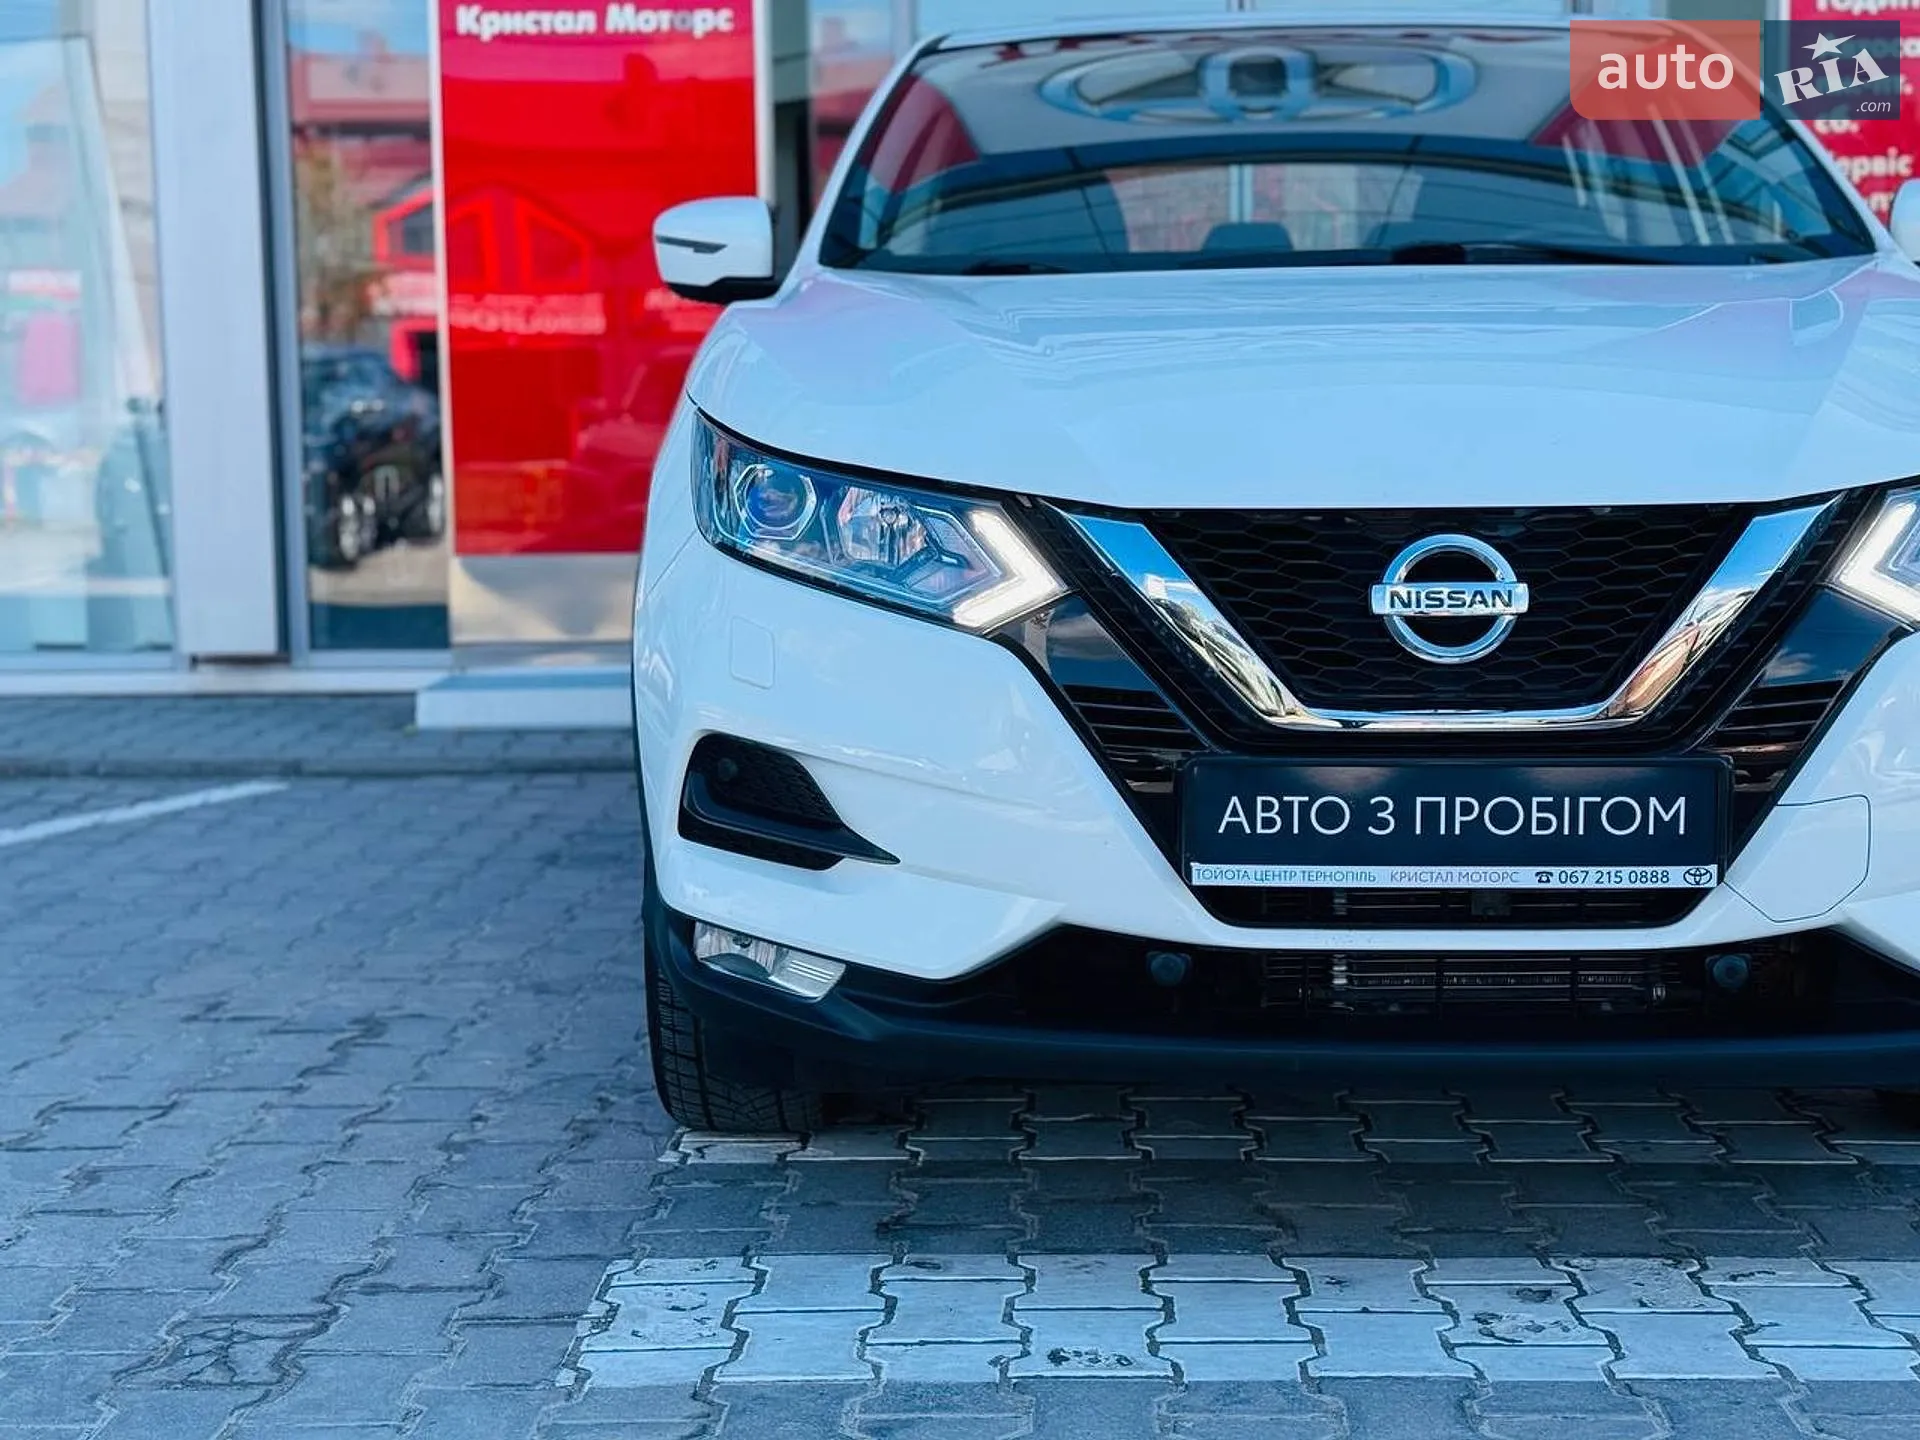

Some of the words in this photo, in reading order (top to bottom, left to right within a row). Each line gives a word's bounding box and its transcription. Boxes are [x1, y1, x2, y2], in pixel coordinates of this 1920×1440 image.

[456, 4, 597, 41] Кристал
[605, 2, 734, 39] Моторс
[1389, 589, 1513, 609] NISSAN
[1218, 795, 1351, 836] АВТО
[1415, 796, 1686, 836] ПРОБІГОМ
[1195, 868, 1250, 881] ТОЙОТА
[1254, 870, 1297, 883] ЦЕНТР
[1301, 871, 1376, 883] ТЕРНОПІЛЬ
[1390, 872, 1453, 884] КРИСТАЛ
[1457, 872, 1519, 884] МОТОРС
[1558, 870, 1589, 885] 067
[1595, 870, 1623, 885] 215
[1628, 870, 1670, 884] 0888
